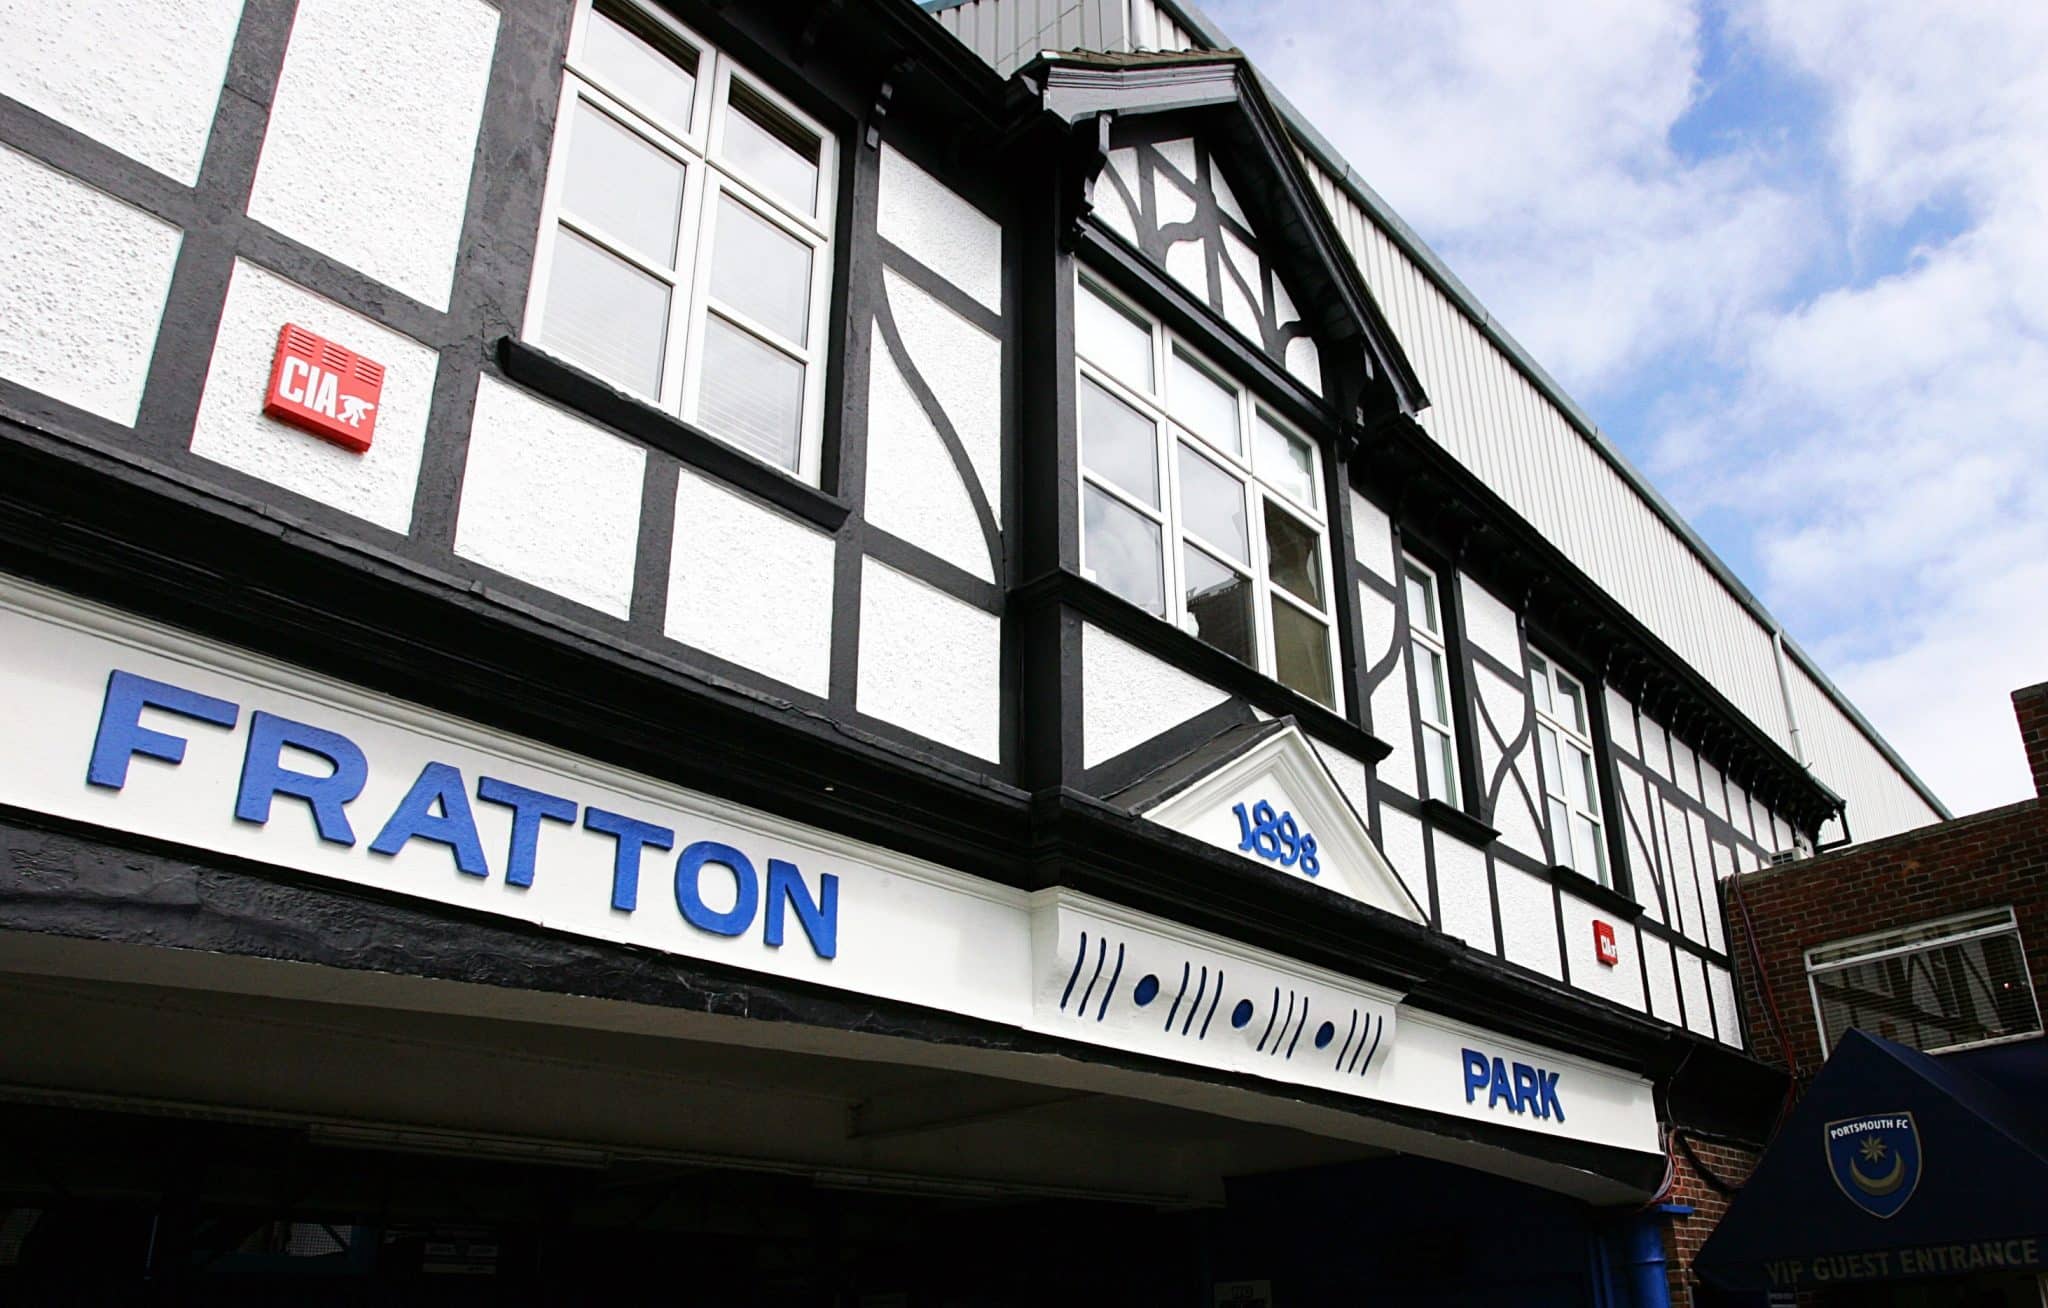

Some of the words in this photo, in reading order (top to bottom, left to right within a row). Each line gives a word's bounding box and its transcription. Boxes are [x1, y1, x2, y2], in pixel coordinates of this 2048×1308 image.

[279, 355, 339, 419] CIA
[87, 671, 838, 960] FRATTON
[1232, 799, 1320, 879] 1898
[1461, 1047, 1566, 1123] PARK
[1830, 1120, 1893, 1139] PORTSMOUTH
[1896, 1119, 1909, 1129] FC
[1765, 1260, 1805, 1285] VIP
[1814, 1253, 1889, 1280] GUEST
[1900, 1239, 2039, 1273] ENTRANCE
